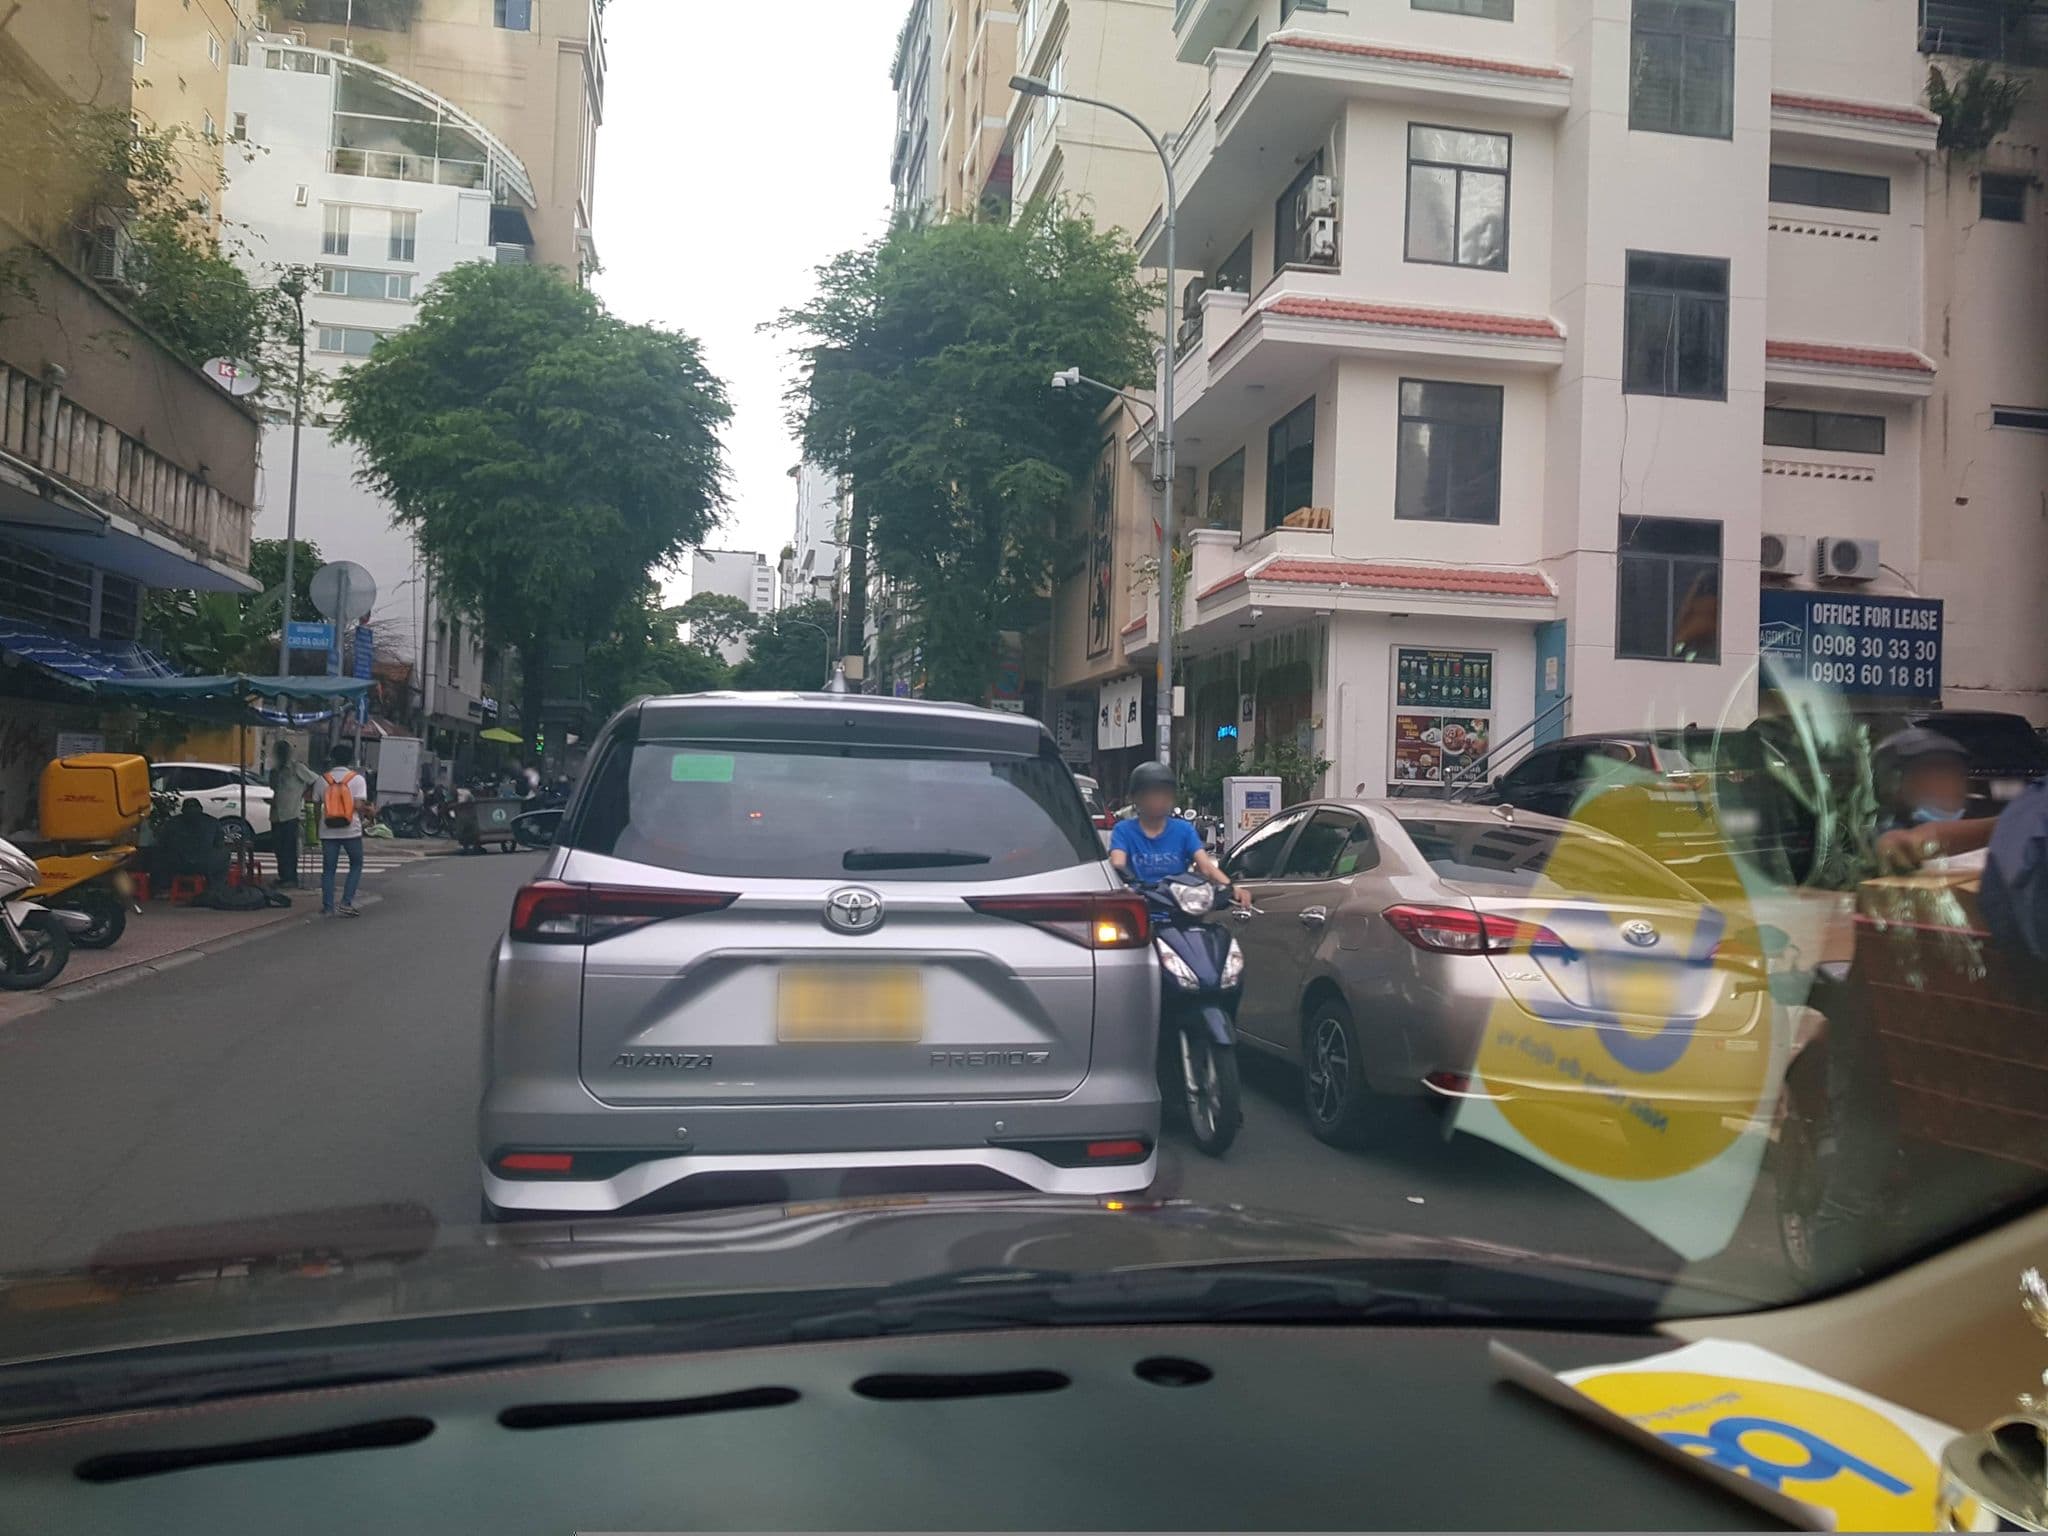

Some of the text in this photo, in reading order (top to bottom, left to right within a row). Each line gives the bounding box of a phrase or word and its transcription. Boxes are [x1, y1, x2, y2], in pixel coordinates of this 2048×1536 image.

[1813, 603, 1938, 631] OFFICE FOR LEASE
[1786, 631, 1803, 647] FLY
[1812, 634, 1856, 657] 0908
[1861, 637, 1883, 658] 30
[1888, 638, 1910, 660] 33
[1914, 640, 1937, 661] 30
[1812, 662, 1934, 688] 0903 60 18 81
[612, 1053, 713, 1070] AVANZA
[931, 1051, 1024, 1067] PREMIO
